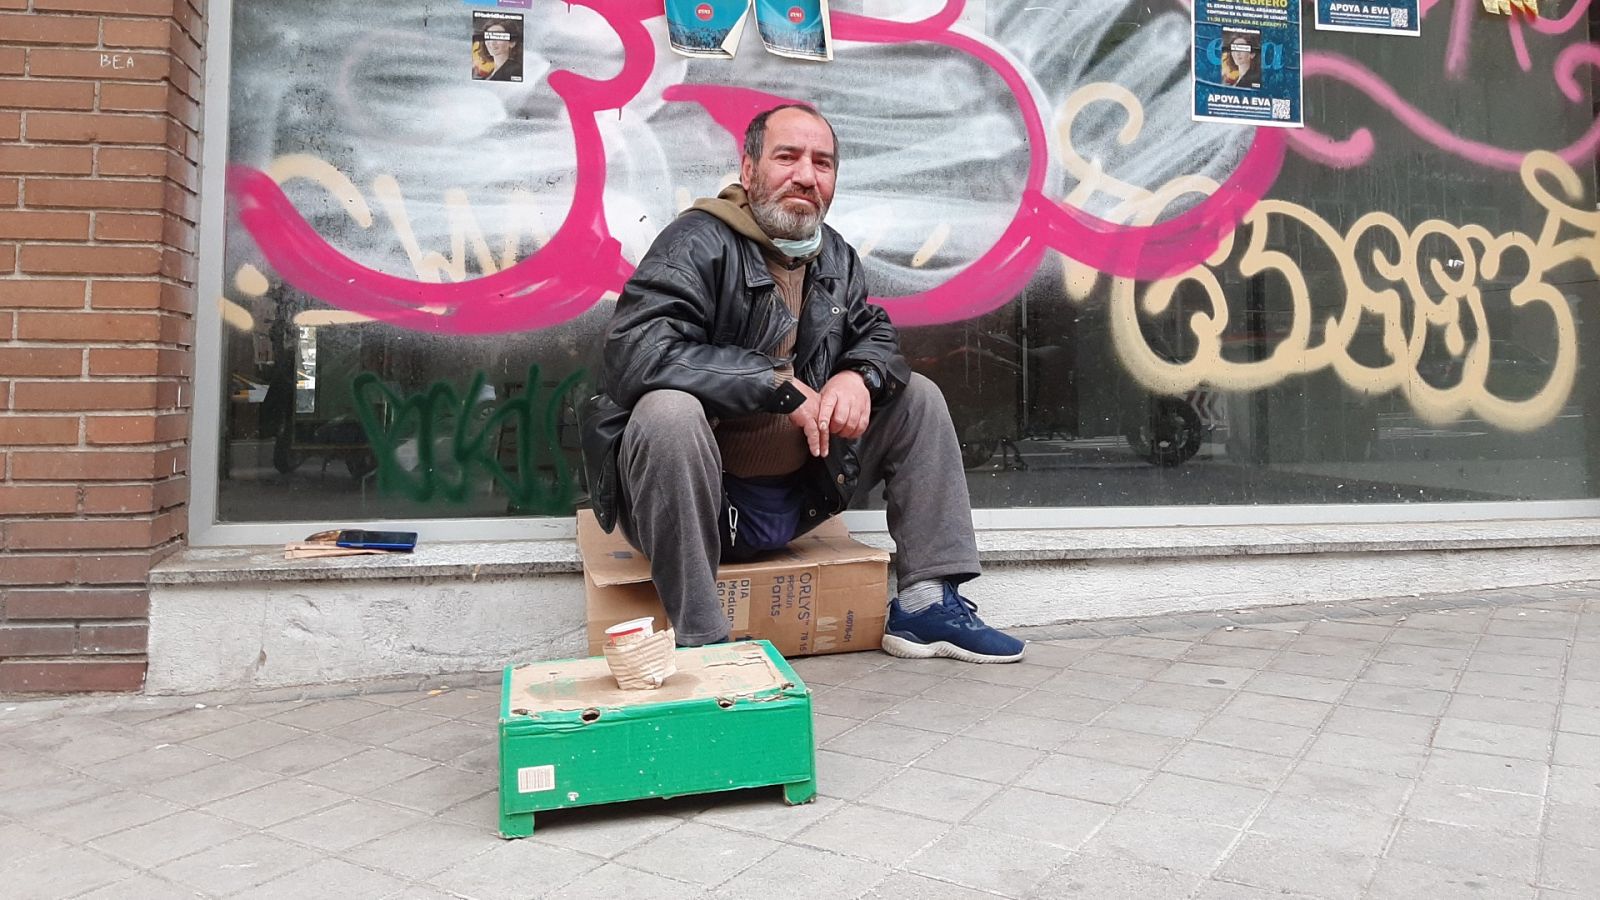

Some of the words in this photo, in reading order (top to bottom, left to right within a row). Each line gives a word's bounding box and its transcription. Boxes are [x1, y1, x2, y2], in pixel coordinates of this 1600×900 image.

[1329, 3, 1360, 13] APOYA
[1362, 6, 1369, 14] A
[1371, 6, 1390, 15] EVA
[100, 53, 134, 70] BEA
[1207, 94, 1240, 104] APOYA
[1242, 96, 1249, 105] A
[1251, 97, 1271, 106] EVA
[740, 579, 750, 599] DIA
[770, 576, 785, 617] Pants
[727, 580, 738, 628] Median
